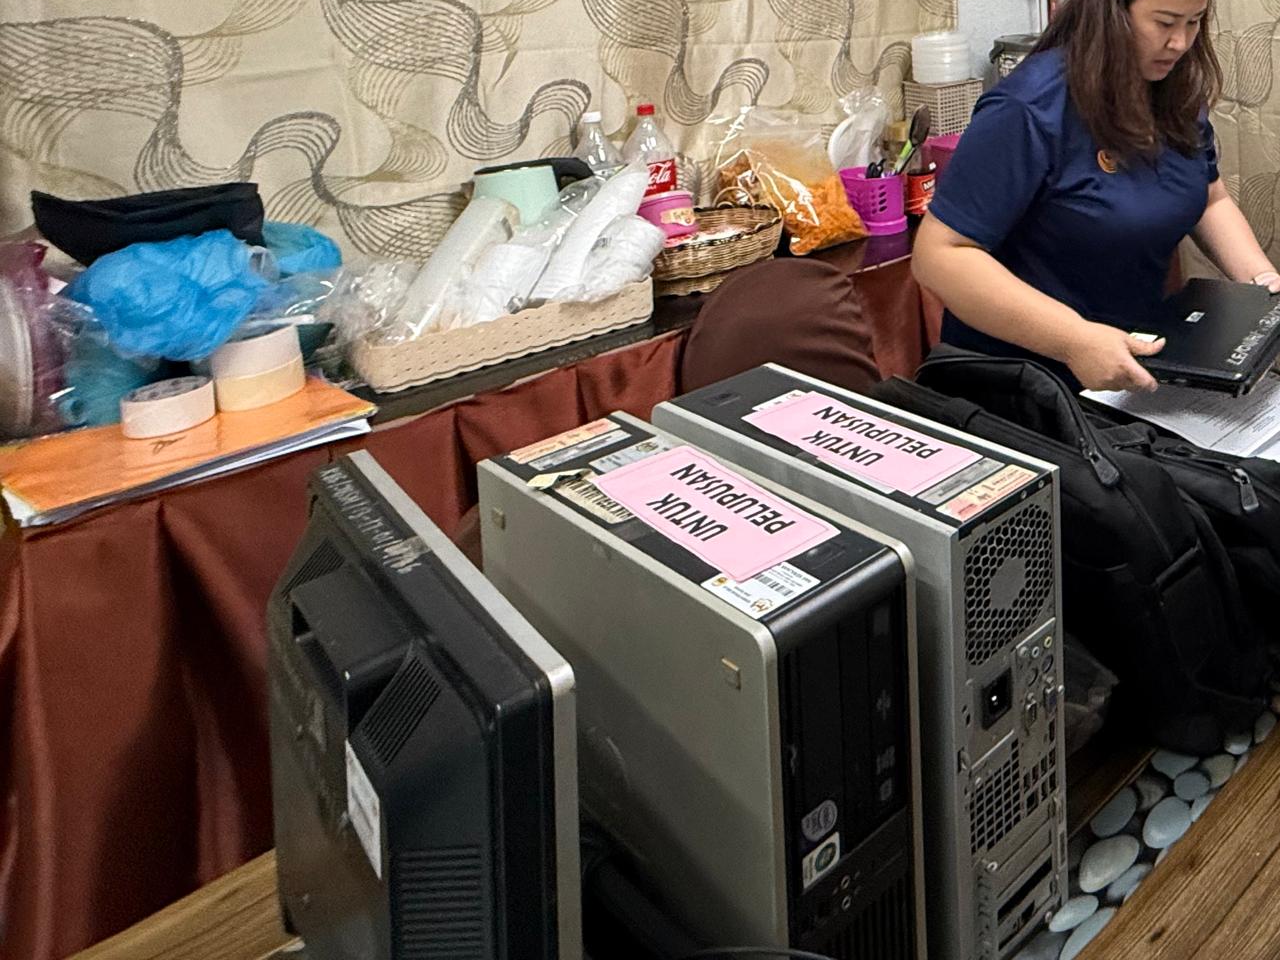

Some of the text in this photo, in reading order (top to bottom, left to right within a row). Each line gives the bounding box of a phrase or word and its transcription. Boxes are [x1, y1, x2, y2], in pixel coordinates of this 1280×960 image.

[800, 430, 884, 466] UNTUK
[812, 406, 943, 459] PELUPUSAN
[645, 493, 729, 542] UNTUK
[669, 463, 797, 535] PELUPUSAN
